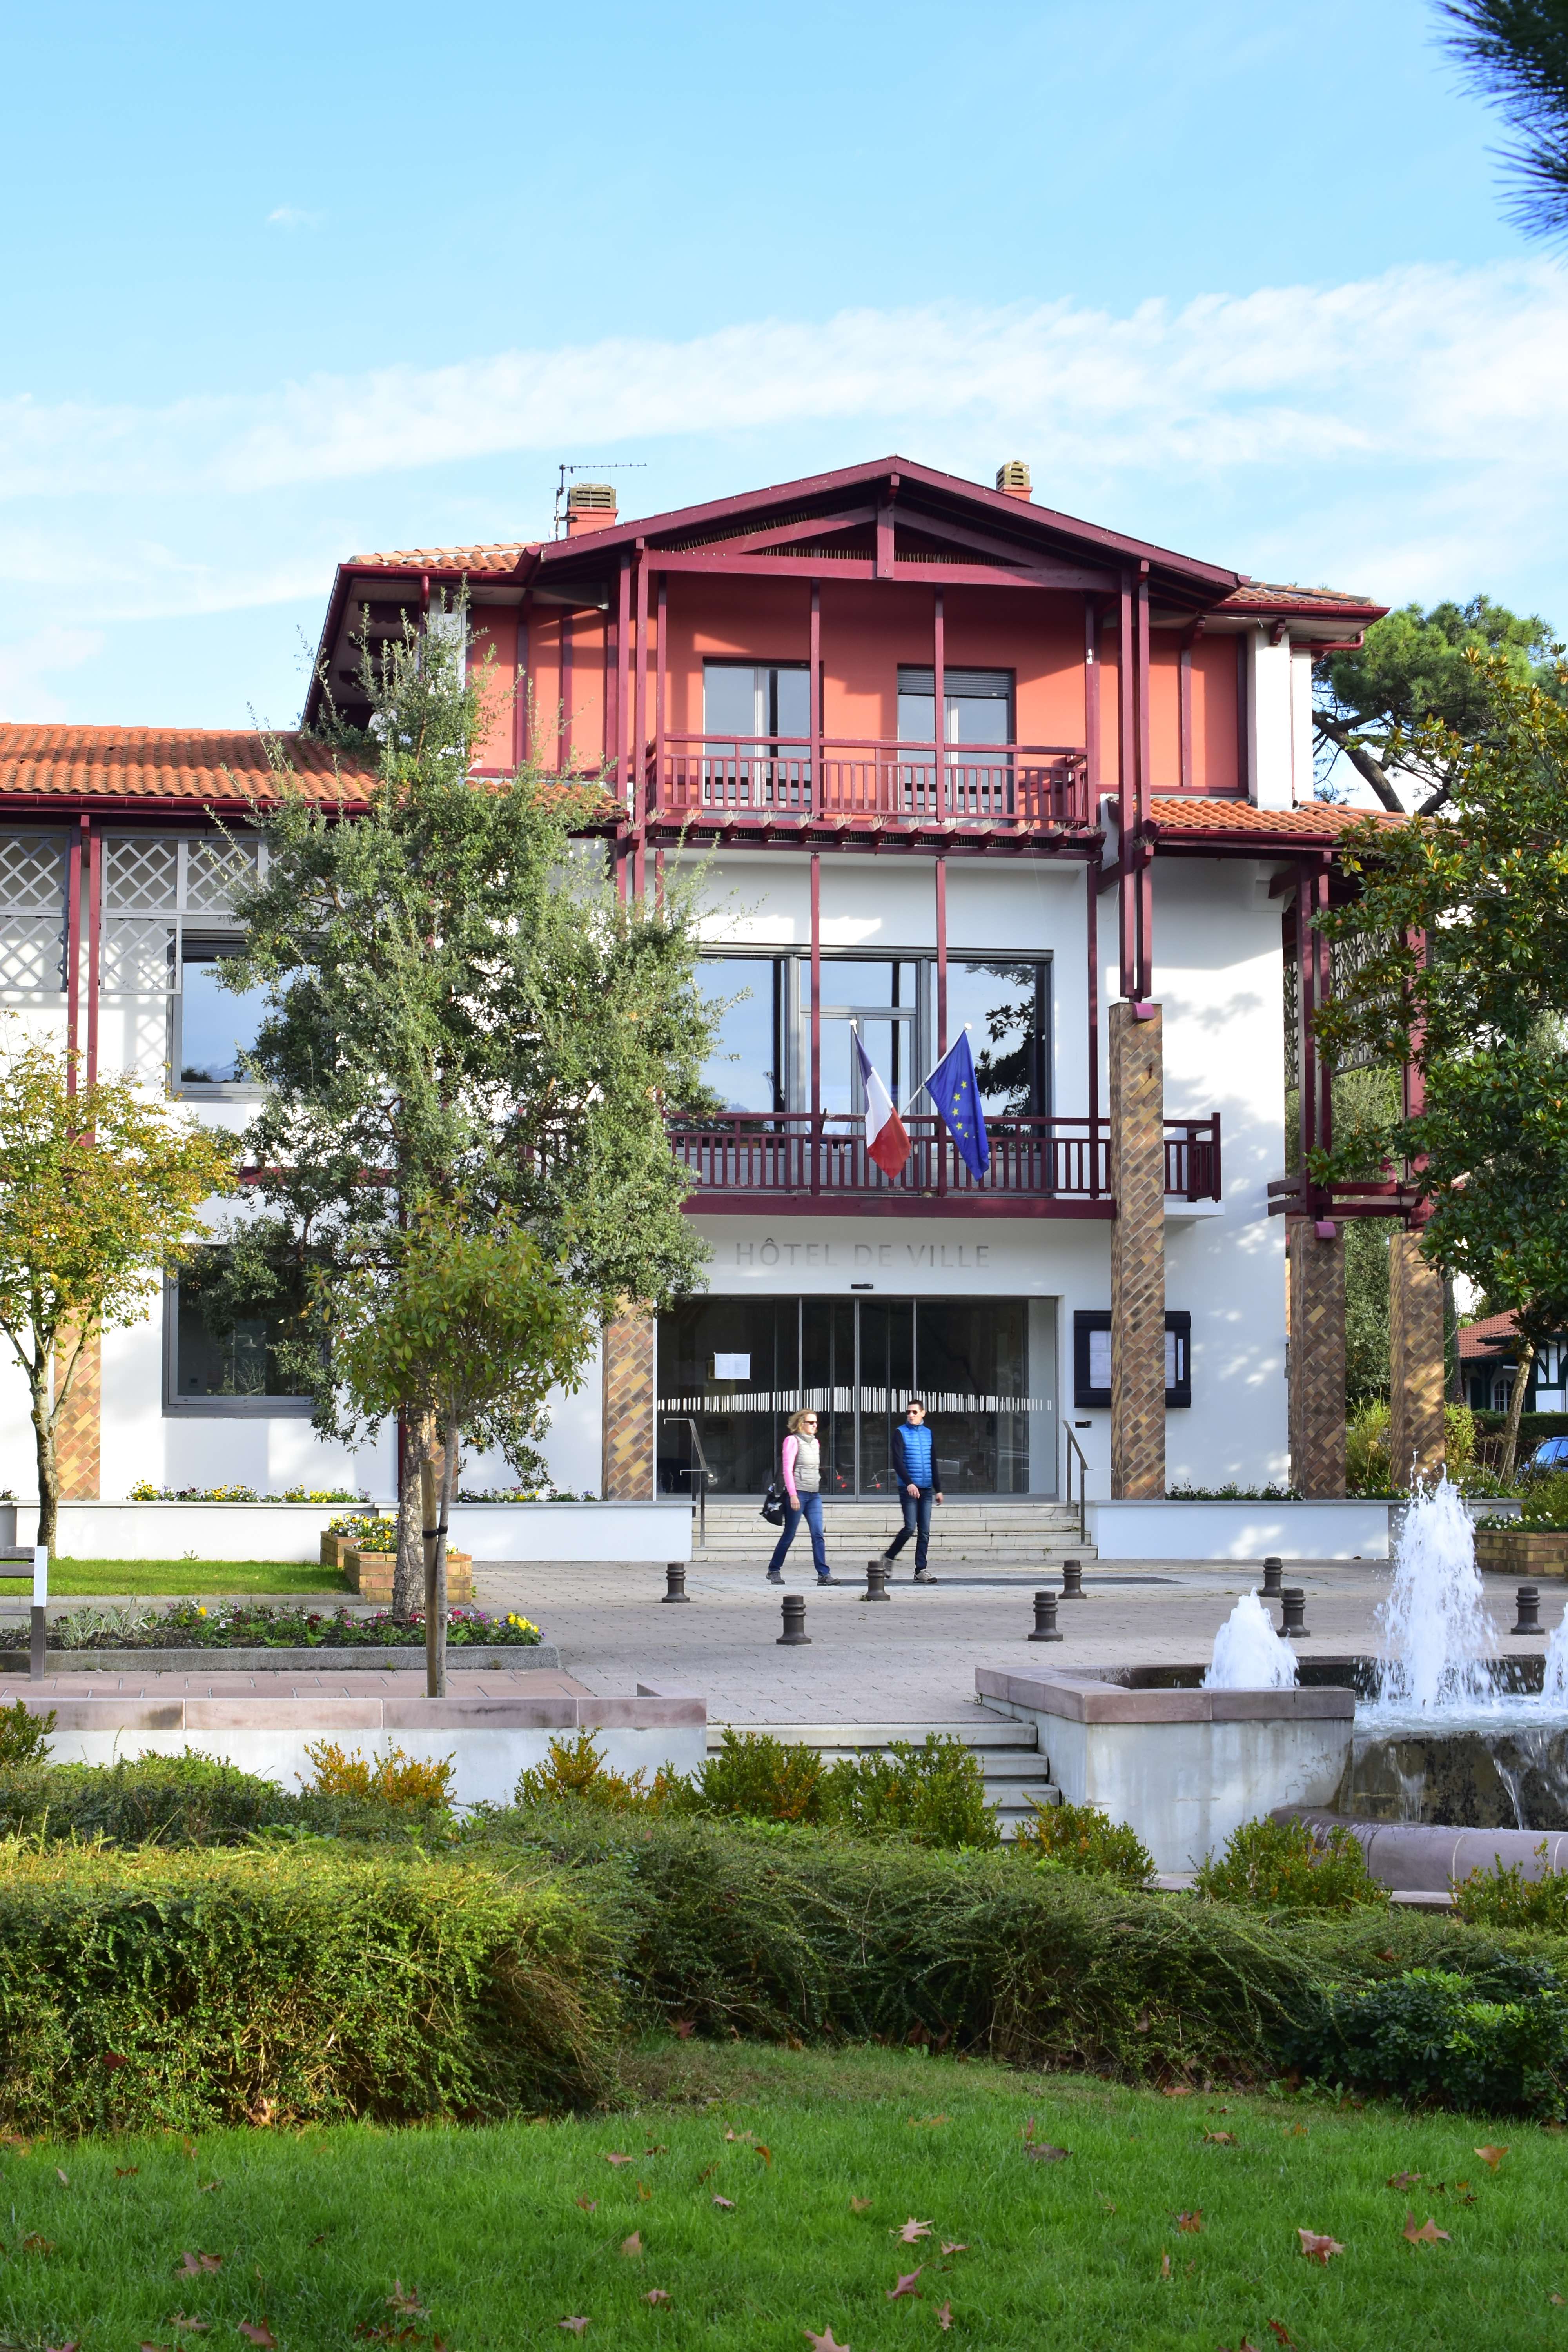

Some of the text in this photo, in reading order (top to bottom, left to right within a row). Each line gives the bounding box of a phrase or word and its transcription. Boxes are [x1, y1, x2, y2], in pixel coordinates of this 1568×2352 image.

[737, 1237, 990, 1267] HÔTEL DE VILLE
